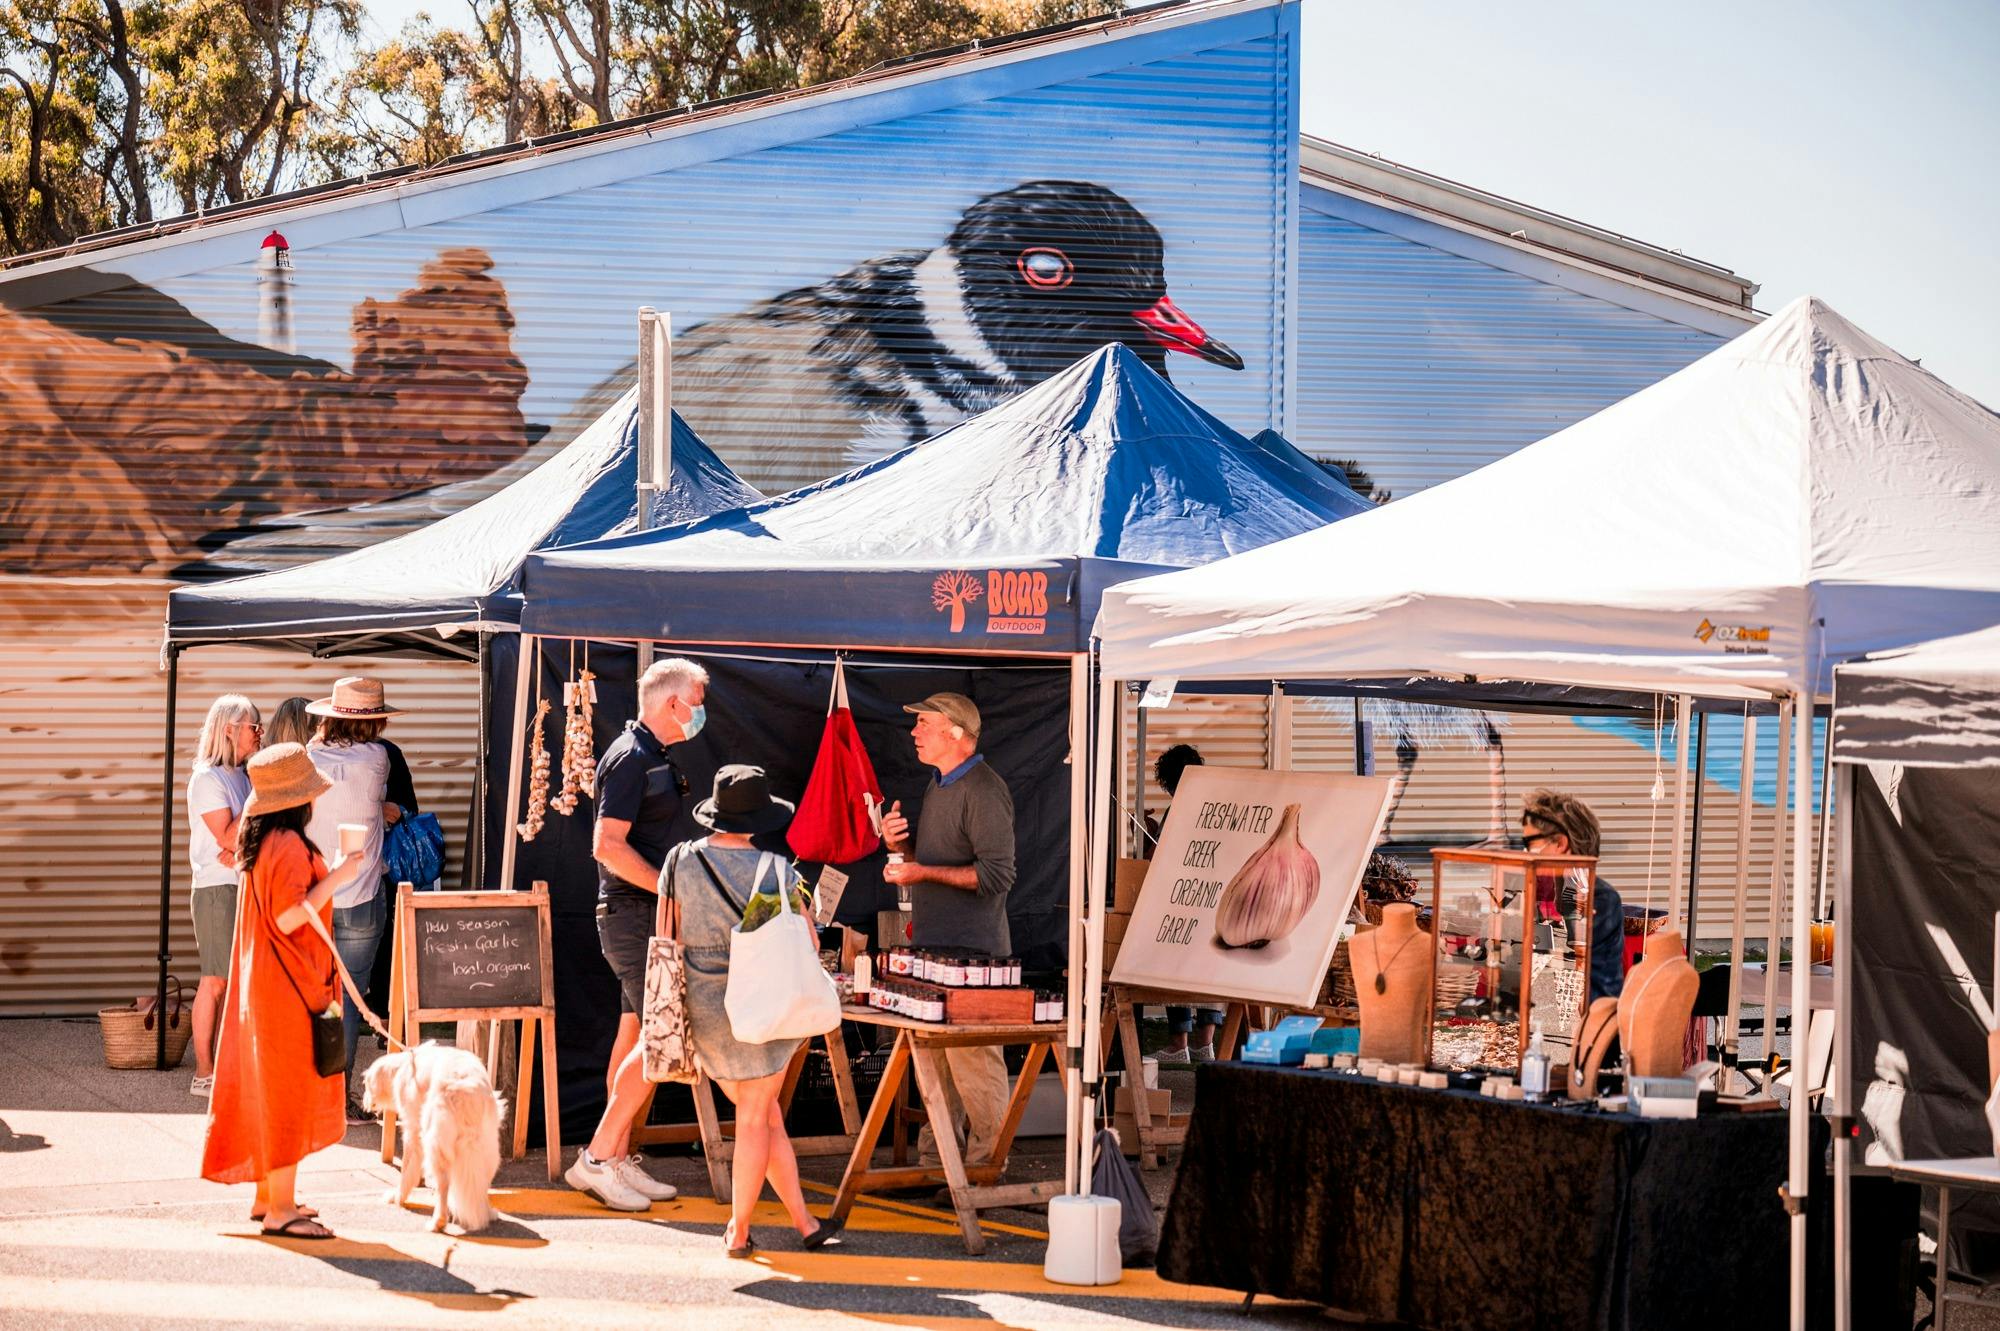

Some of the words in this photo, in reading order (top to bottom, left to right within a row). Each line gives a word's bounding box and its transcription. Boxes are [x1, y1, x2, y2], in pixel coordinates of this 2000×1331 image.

[987, 570, 1048, 616] BOAB
[991, 621, 1041, 631] OUTDOOR
[1196, 802, 1273, 834] FRESHWATER
[1182, 840, 1222, 868] CREEK
[1169, 878, 1223, 909] ORGANIC
[456, 919, 509, 931] season
[1155, 914, 1198, 945] GARLIC
